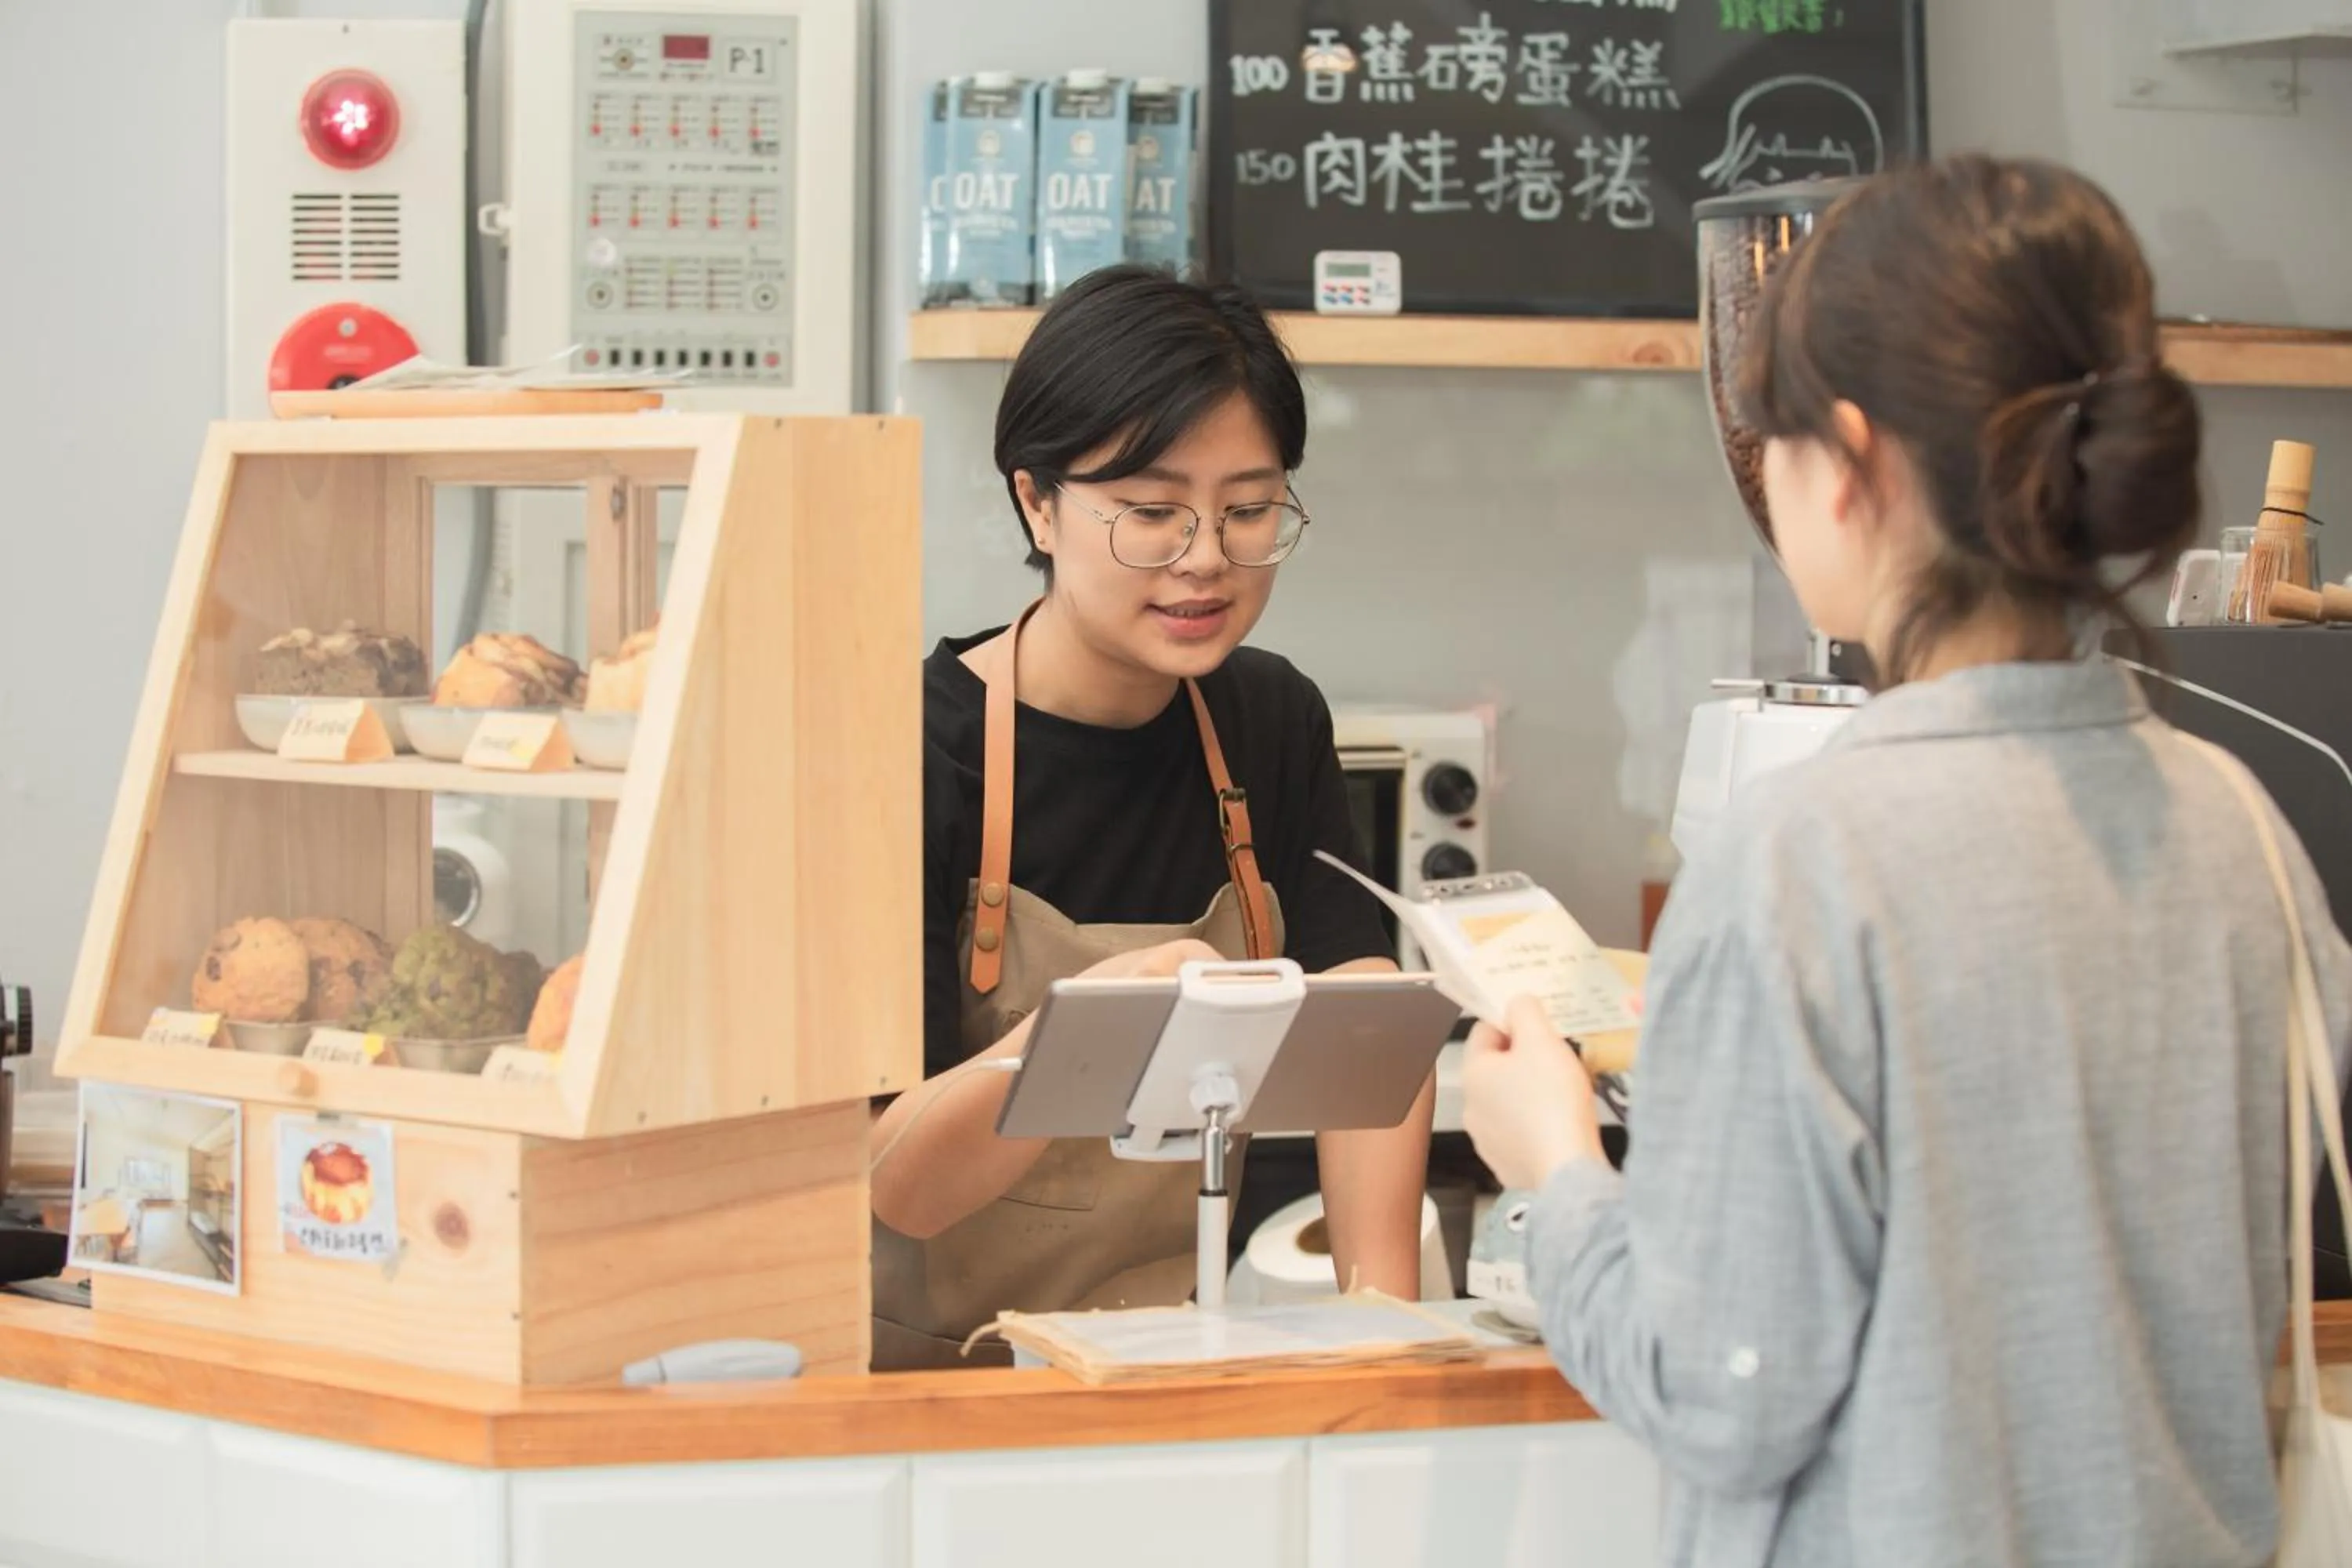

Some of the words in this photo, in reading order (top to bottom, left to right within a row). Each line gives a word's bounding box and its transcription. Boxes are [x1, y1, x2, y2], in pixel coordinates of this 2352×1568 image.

[1229, 54, 1290, 96] 100
[1301, 11, 1681, 109] 香蕉磅蛋糕
[954, 172, 1019, 210] OAT
[1047, 172, 1113, 210] OAT
[1136, 177, 1176, 213] AT
[1236, 149, 1296, 185] 150
[1304, 129, 1653, 228] 肉桂捲捲
